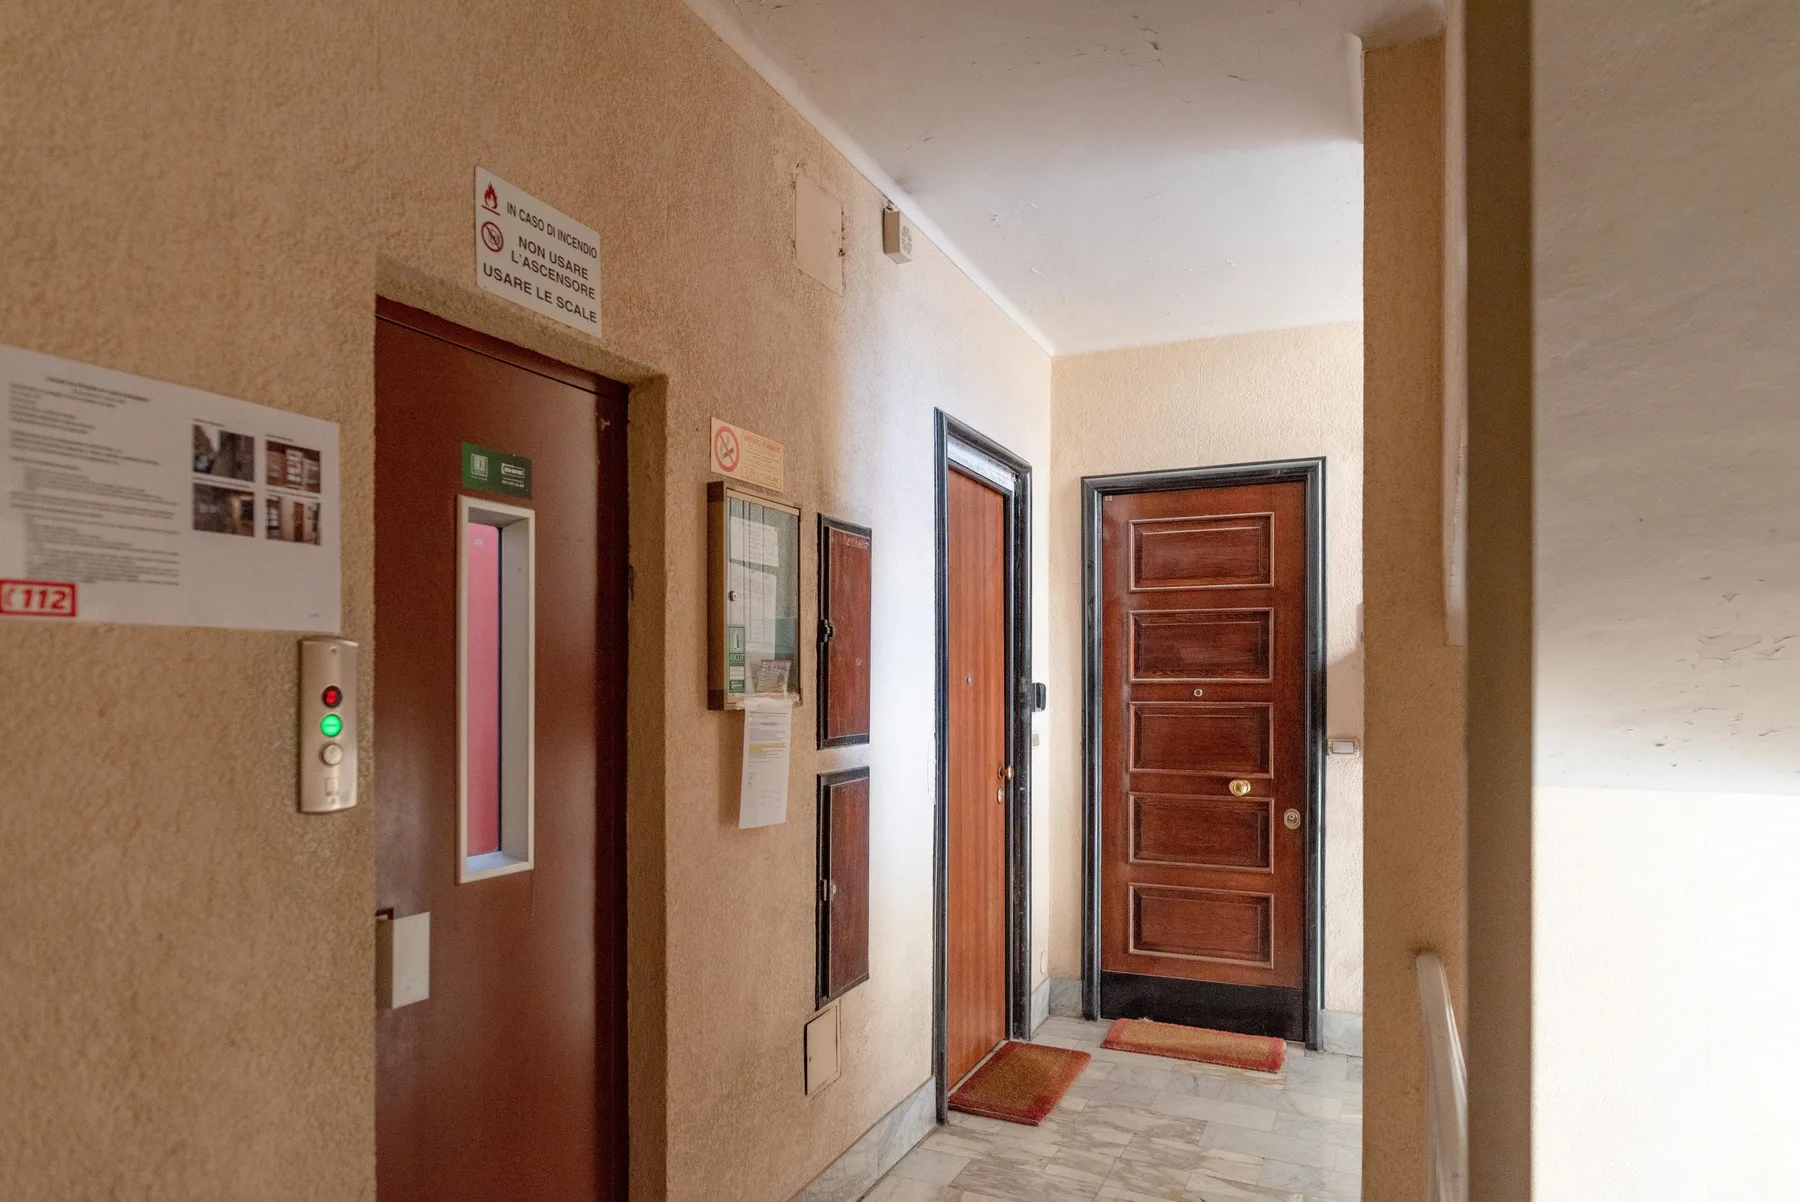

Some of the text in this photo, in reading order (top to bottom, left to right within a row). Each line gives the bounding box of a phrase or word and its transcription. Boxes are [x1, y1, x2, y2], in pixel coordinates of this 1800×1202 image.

[507, 202, 598, 259] IN CASO DI INCENDIO
[511, 250, 596, 300] L'ASCENSORE
[518, 235, 589, 281] NON USARE
[484, 263, 597, 323] USARE LE SCALE
[23, 588, 67, 609] 112
